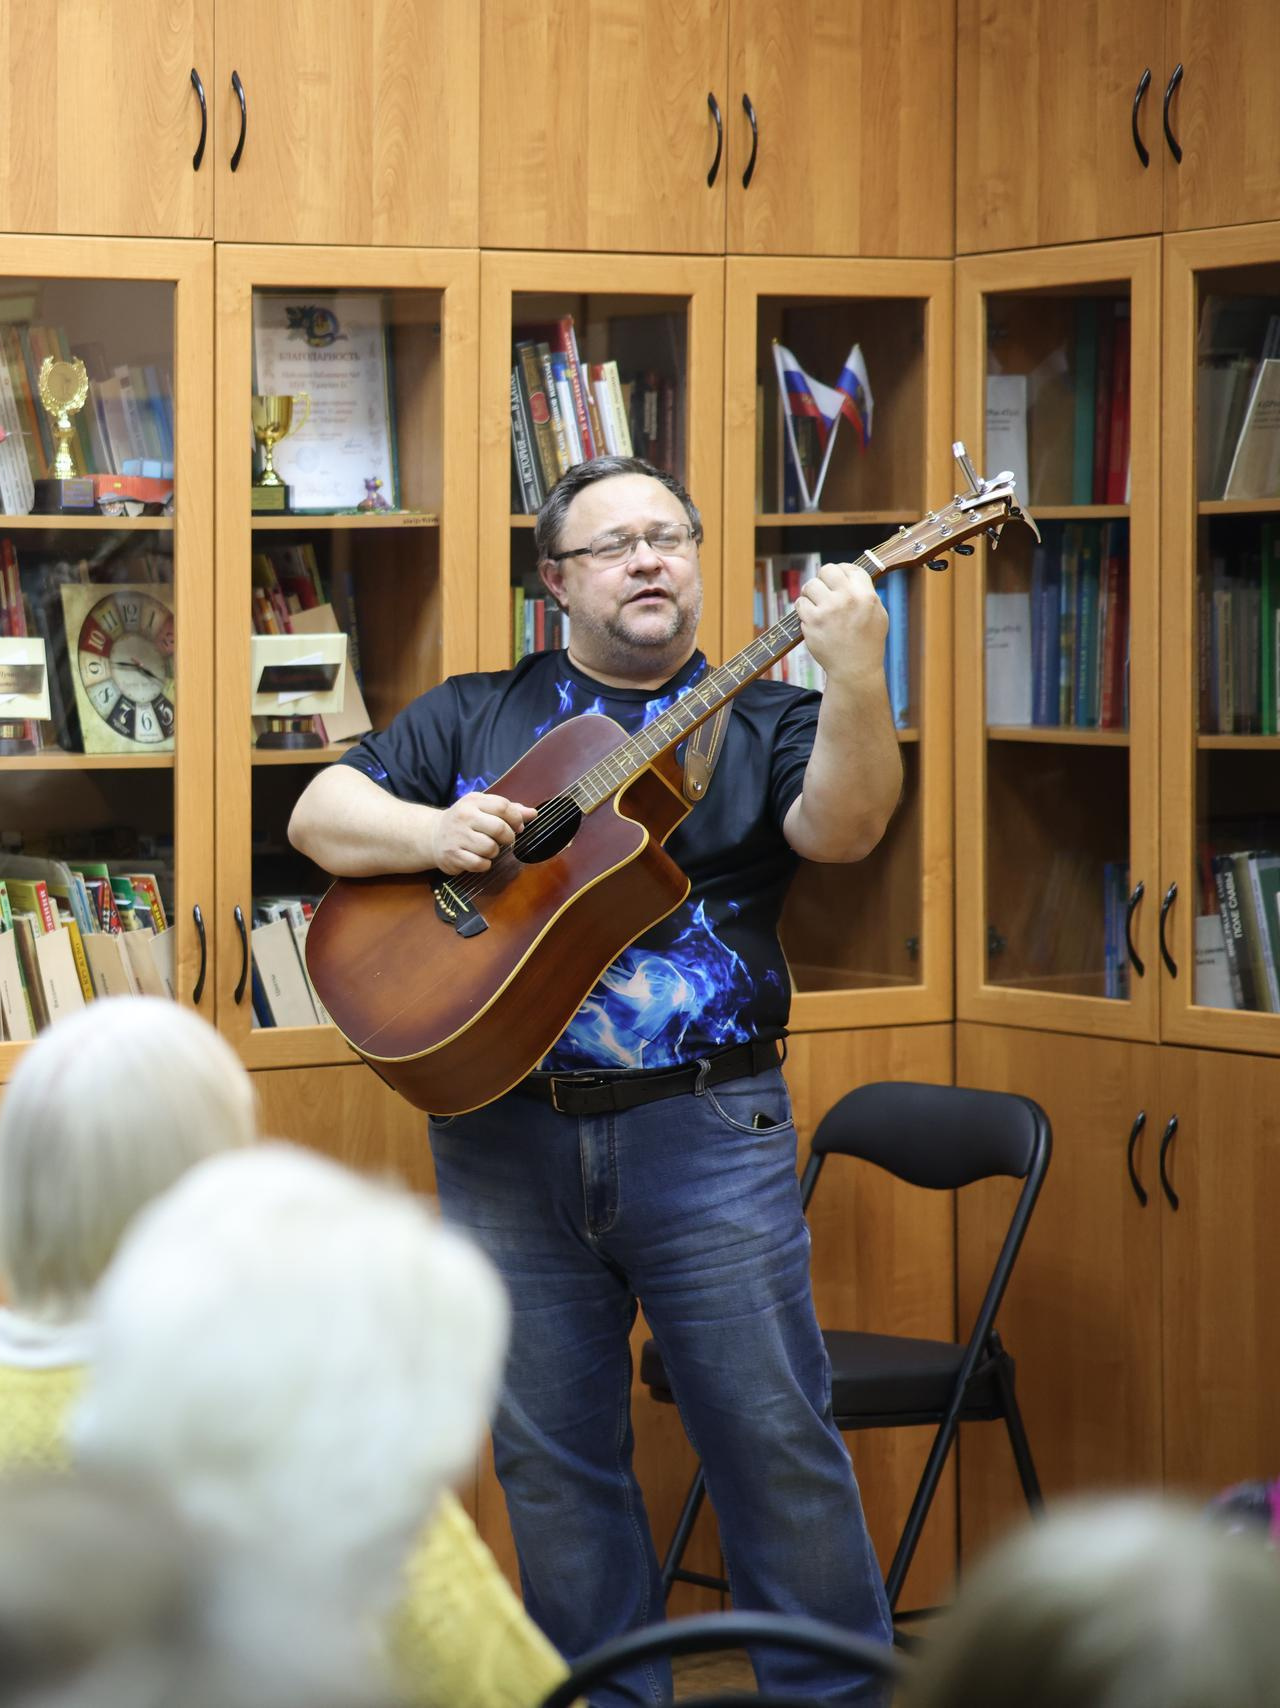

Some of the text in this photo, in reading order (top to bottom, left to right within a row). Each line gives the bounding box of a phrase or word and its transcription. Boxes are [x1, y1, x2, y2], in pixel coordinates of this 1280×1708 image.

[517, 439, 533, 484] ИСТОРИЯ
[102, 610, 118, 631] 11
[122, 603, 138, 624] 12
[147, 609, 156, 633] 1
[88, 631, 107, 651] 10
[88, 660, 102, 675] 9
[99, 686, 114, 705] 8
[120, 703, 131, 724] 7
[141, 711, 153, 732] 6
[1224, 871, 1238, 909] СЛАВЫ
[1231, 909, 1243, 938] ПОЛЕ
